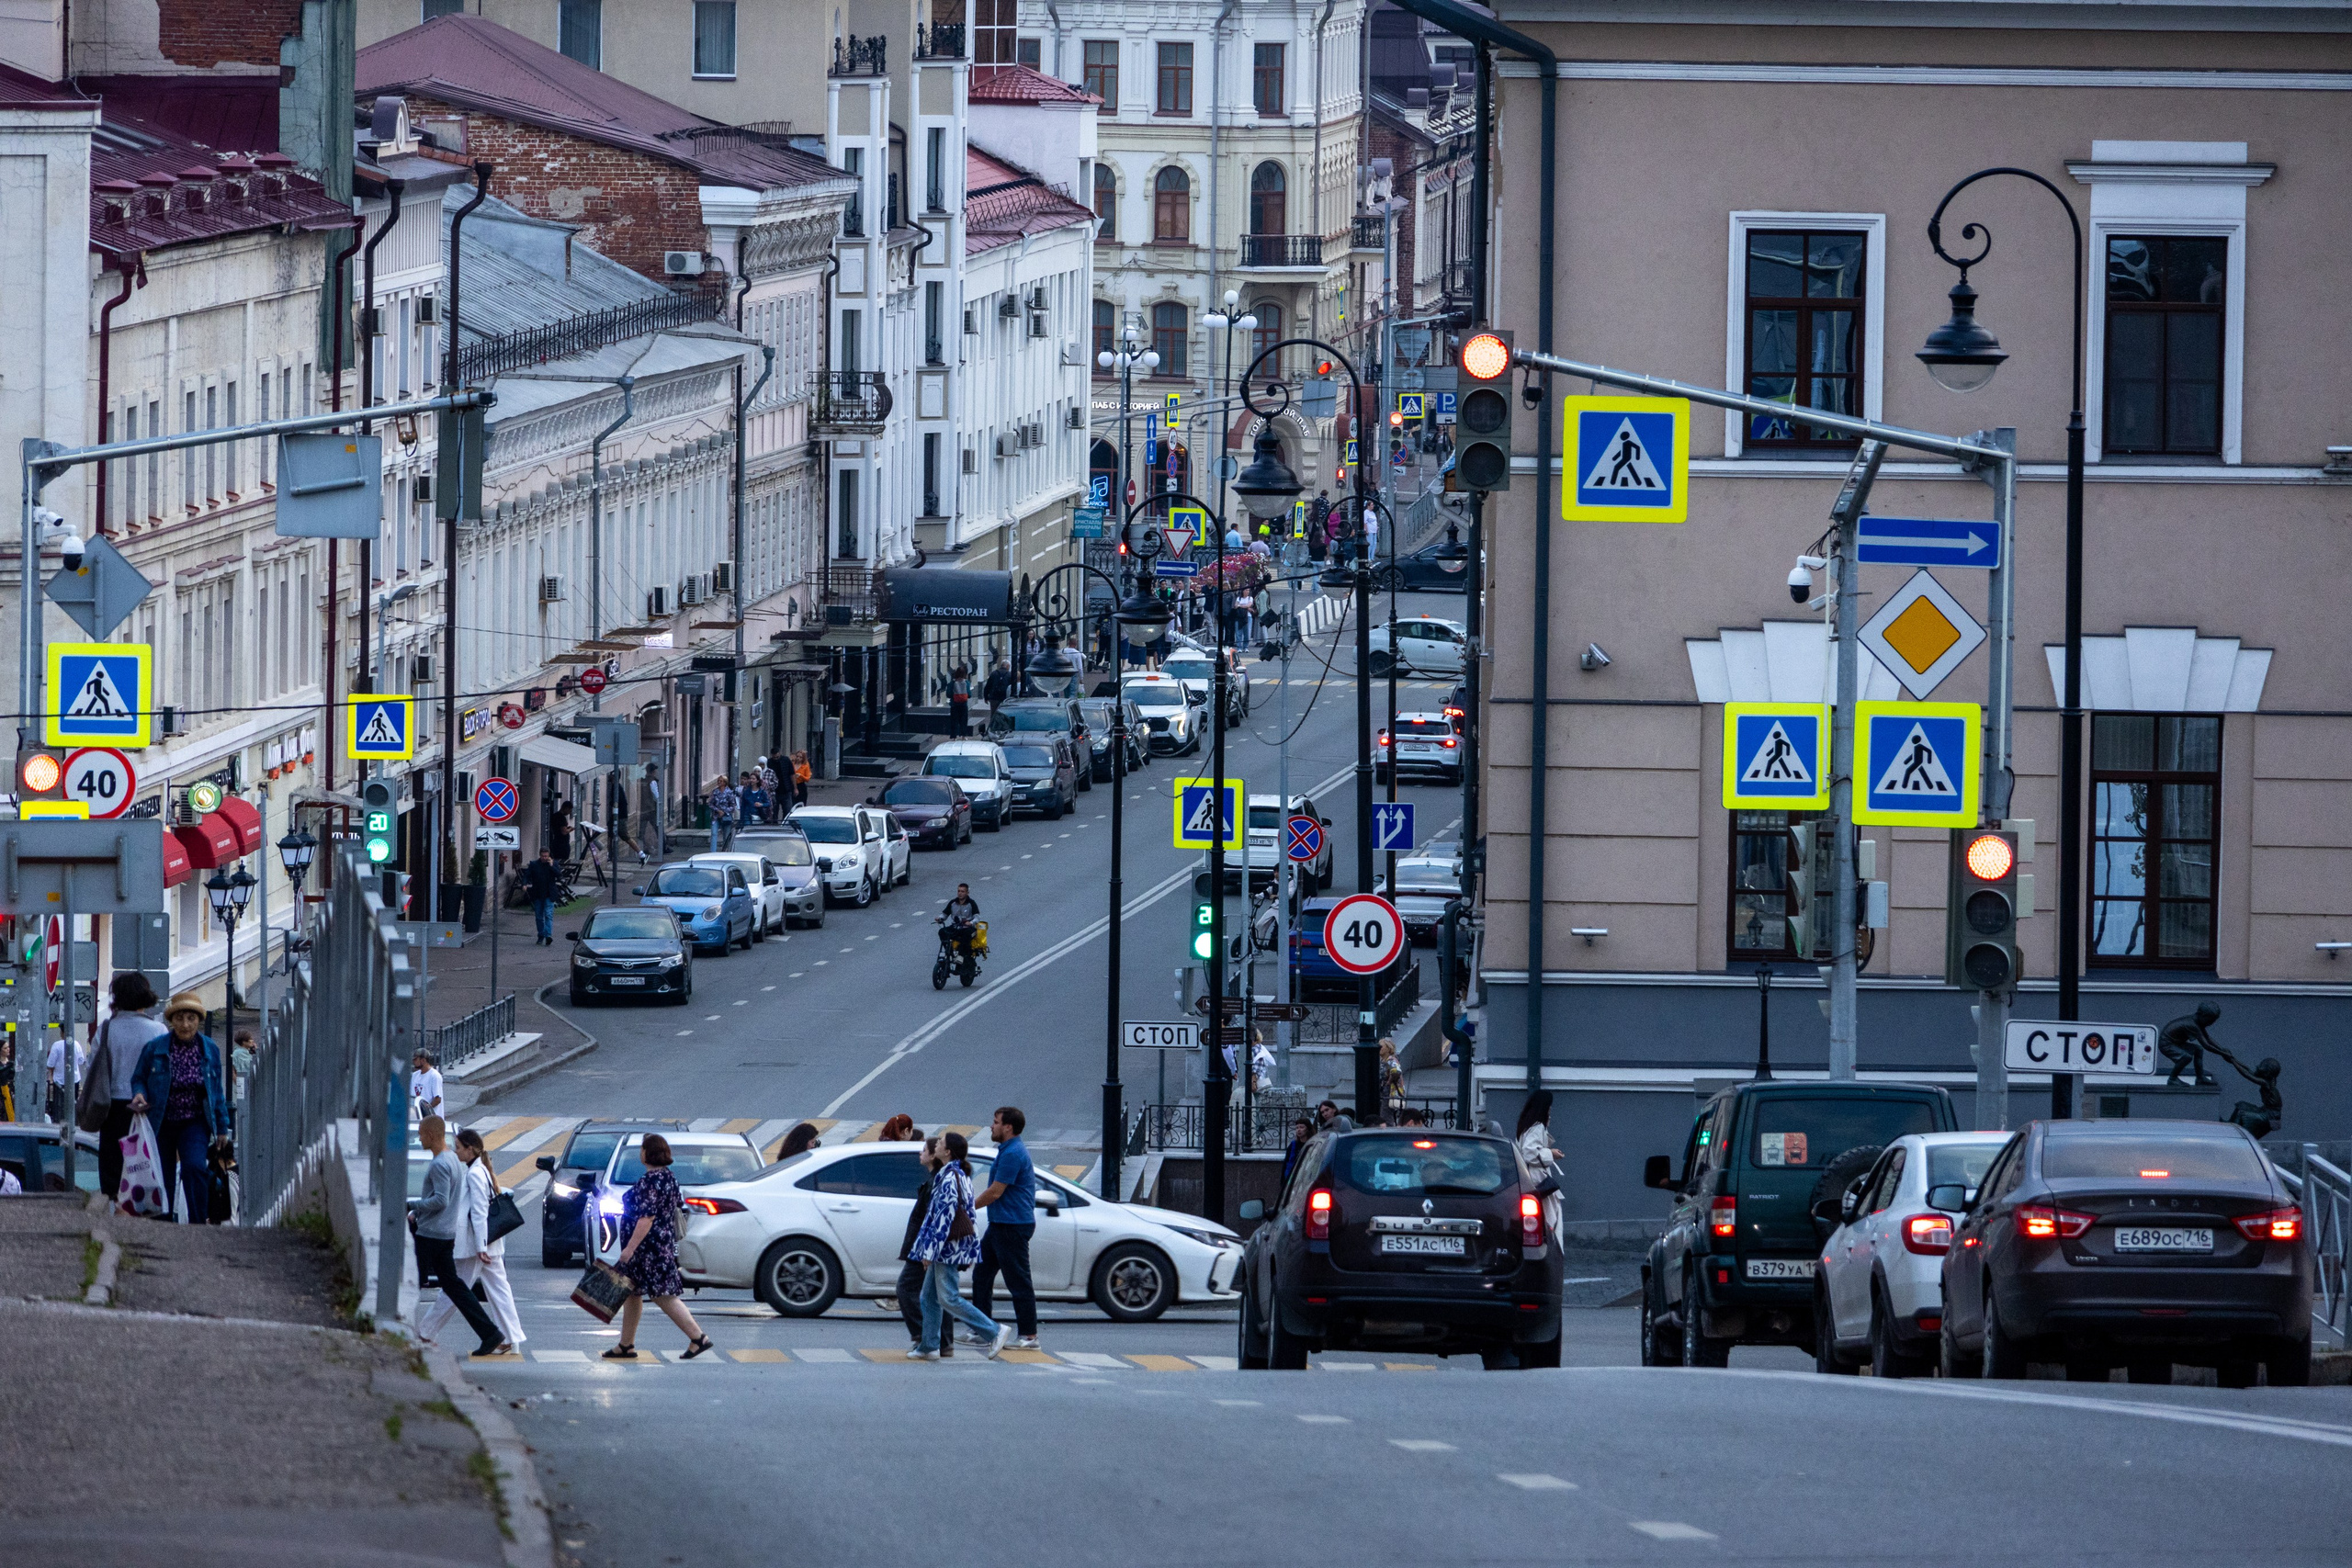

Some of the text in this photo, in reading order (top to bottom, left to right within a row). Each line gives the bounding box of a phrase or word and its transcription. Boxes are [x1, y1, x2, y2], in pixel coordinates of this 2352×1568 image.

[1091, 400, 1108, 410] ПАБ
[1250, 408, 1295, 436] ГОРОСОЙ
[930, 606, 988, 616] РЕСТОРАН
[76, 769, 117, 799] 40
[369, 814, 388, 831] 20
[1343, 919, 1383, 948] 40
[1133, 1026, 1189, 1045] СТОП
[2026, 1030, 2134, 1066] СТОП
[2129, 1199, 2200, 1207] LADA
[1375, 1223, 1478, 1233] DUSTER
